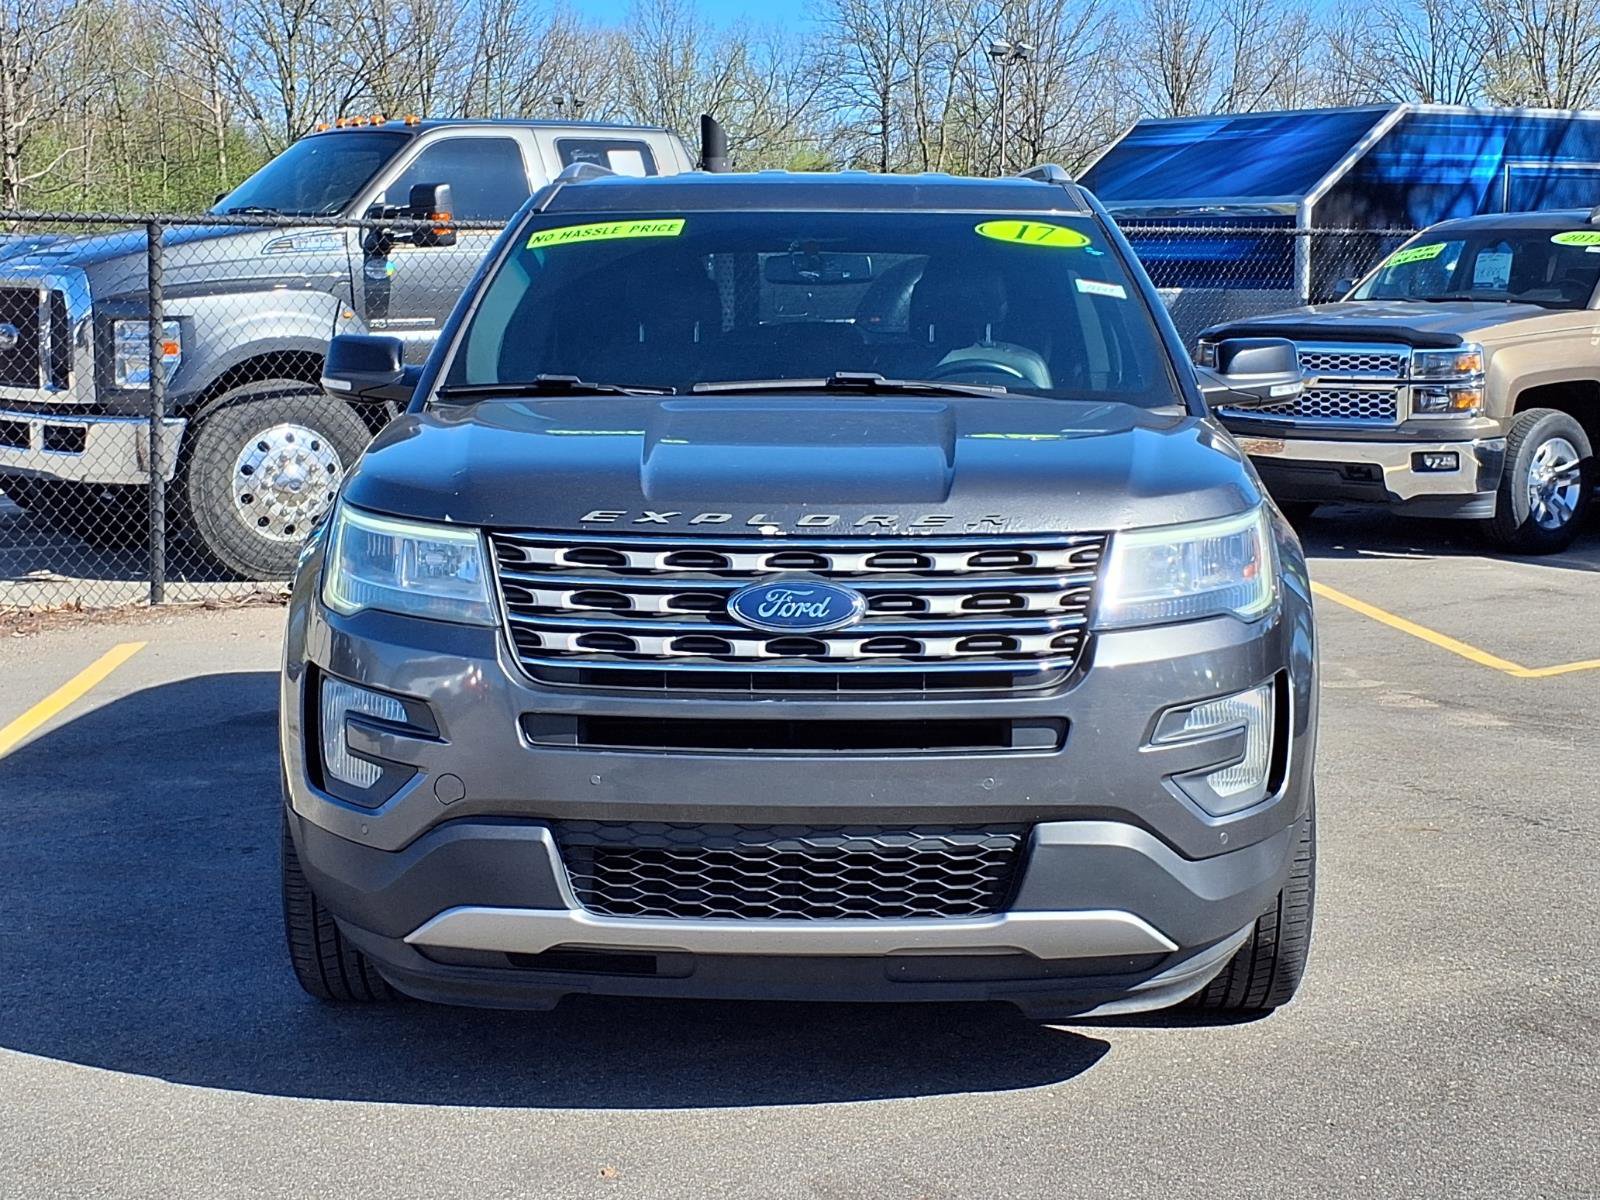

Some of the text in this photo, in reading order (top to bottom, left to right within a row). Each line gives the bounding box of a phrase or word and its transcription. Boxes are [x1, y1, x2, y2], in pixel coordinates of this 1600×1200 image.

[532, 223, 679, 244] NO HASSLE PRICE
[1015, 224, 1057, 241] 17
[580, 509, 1007, 528] EXPLORER
[758, 588, 830, 618] Ford
